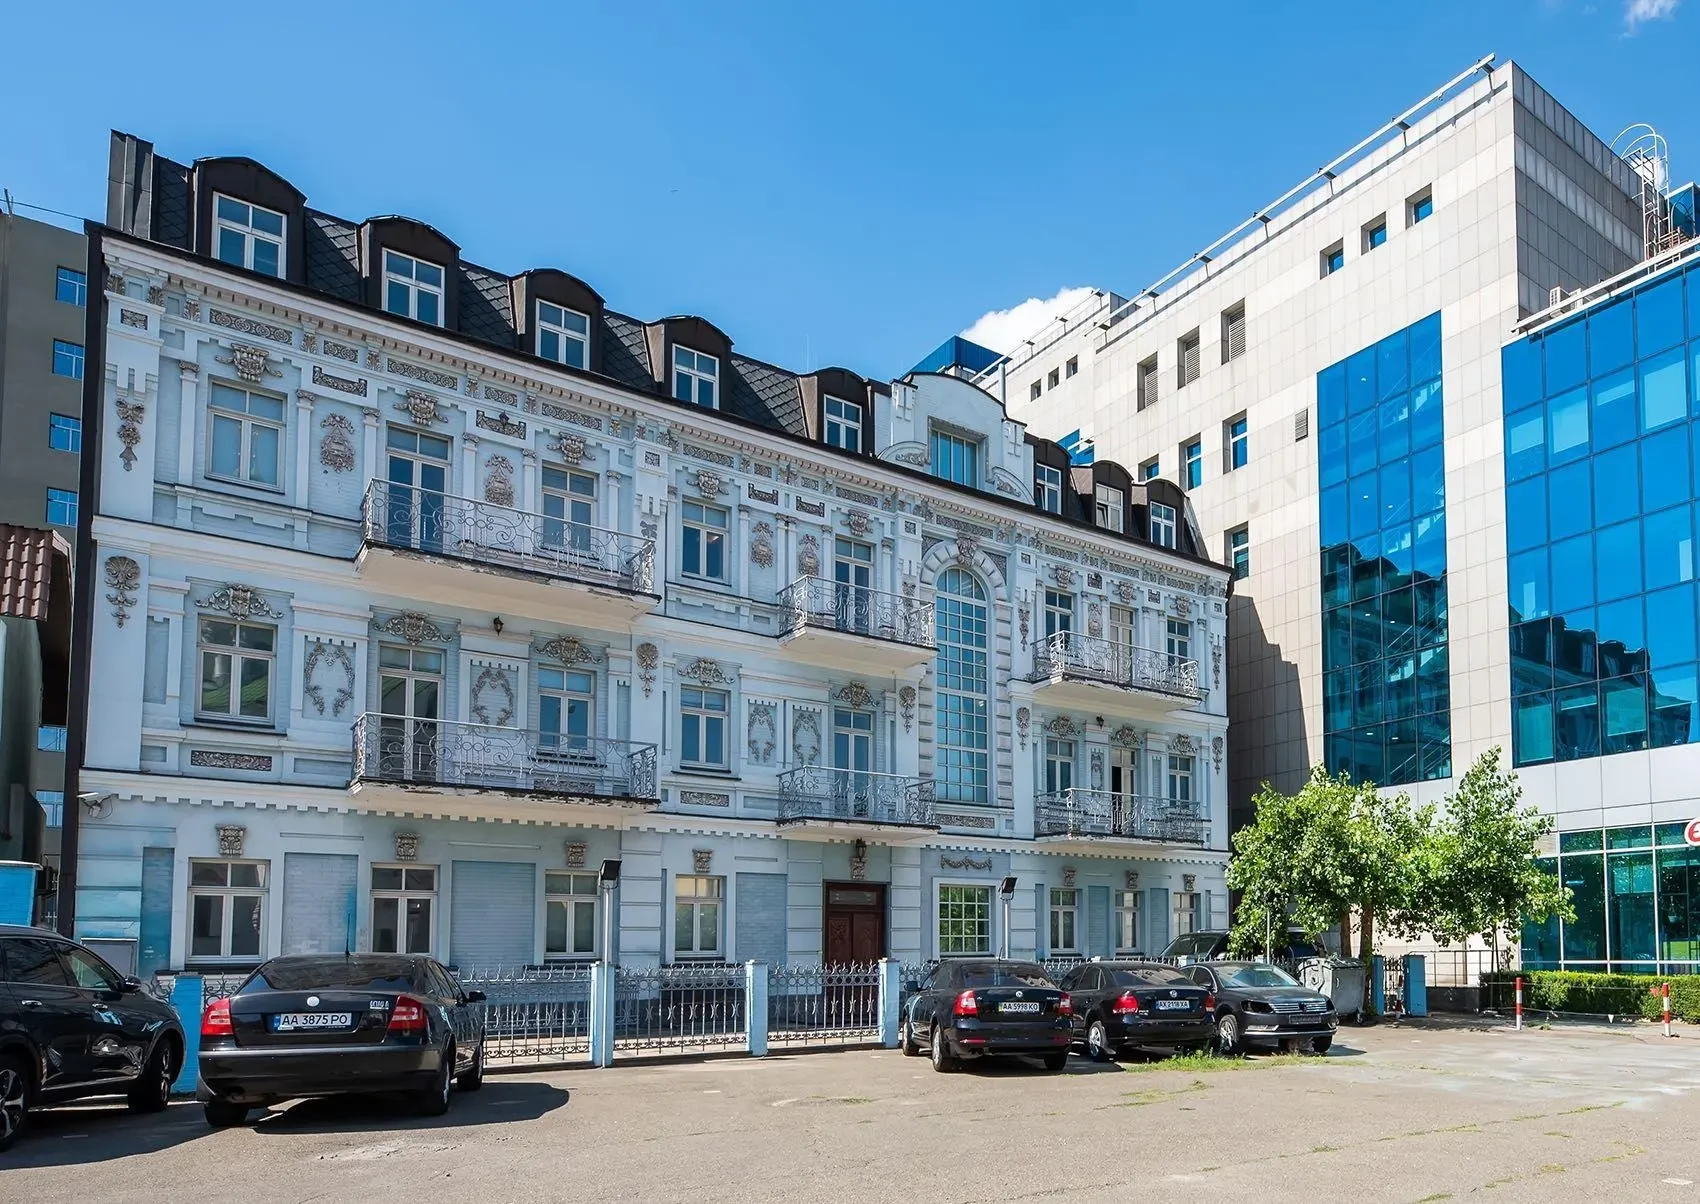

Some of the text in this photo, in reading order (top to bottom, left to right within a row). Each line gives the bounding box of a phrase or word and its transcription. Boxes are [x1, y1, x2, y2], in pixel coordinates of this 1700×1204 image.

[282, 1015, 348, 1025] AA 3875 PO
